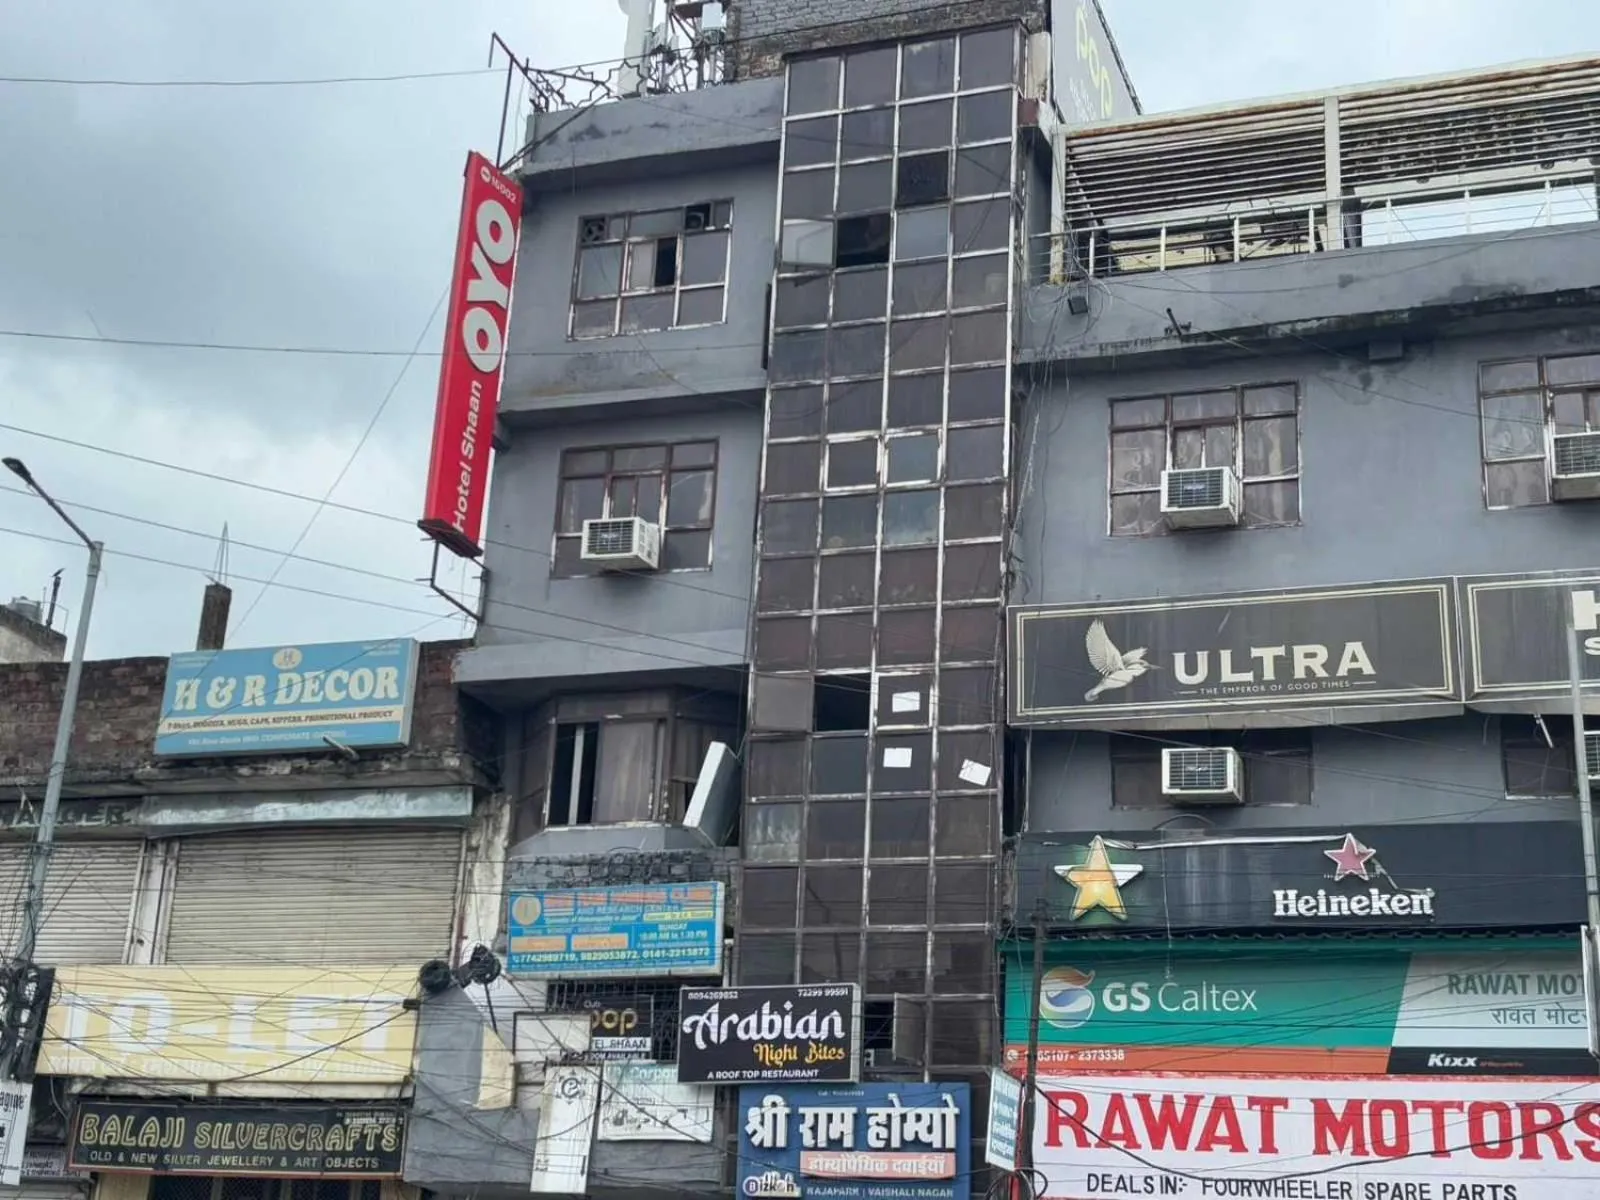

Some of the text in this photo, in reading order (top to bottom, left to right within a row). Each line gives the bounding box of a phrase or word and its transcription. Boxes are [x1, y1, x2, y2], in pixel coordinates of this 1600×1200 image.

[462, 198, 516, 374] OYO
[451, 378, 484, 533] Hotel Shaan
[1172, 640, 1377, 686] ULTRA
[173, 665, 400, 711] H & R DECOR
[1199, 679, 1350, 695] THE EMPEROR OF GOOD TIMES
[1273, 887, 1435, 917] Heineken
[1102, 980, 1258, 1012] GS Caltex
[1447, 973, 1530, 995] RAWAT
[682, 999, 846, 1050] Arabian
[753, 1040, 846, 1067] Night Bites
[1427, 1053, 1478, 1067] Kixx
[706, 1068, 819, 1080] A ROOF TOP RESTAURANT
[79, 1113, 400, 1152] BALAJI SILVERCRAFTS
[744, 1094, 791, 1149] श्री
[798, 1106, 858, 1149] राम
[866, 1093, 960, 1149] होम्यो
[1043, 1090, 1289, 1154] RAWAT
[1310, 1097, 1600, 1163] MOTORS
[90, 1150, 380, 1169] OLD & NEW SILVER JEWELLERY & ART OBJECTS
[867, 1187, 915, 1198] VAISHALI
[917, 1188, 954, 1198] NAGAR
[1086, 1173, 1155, 1195] DEALS
[1201, 1178, 1352, 1200] FOURWHEELER
[1364, 1182, 1431, 1200] SPARE
[1441, 1182, 1517, 1200] PARTS
